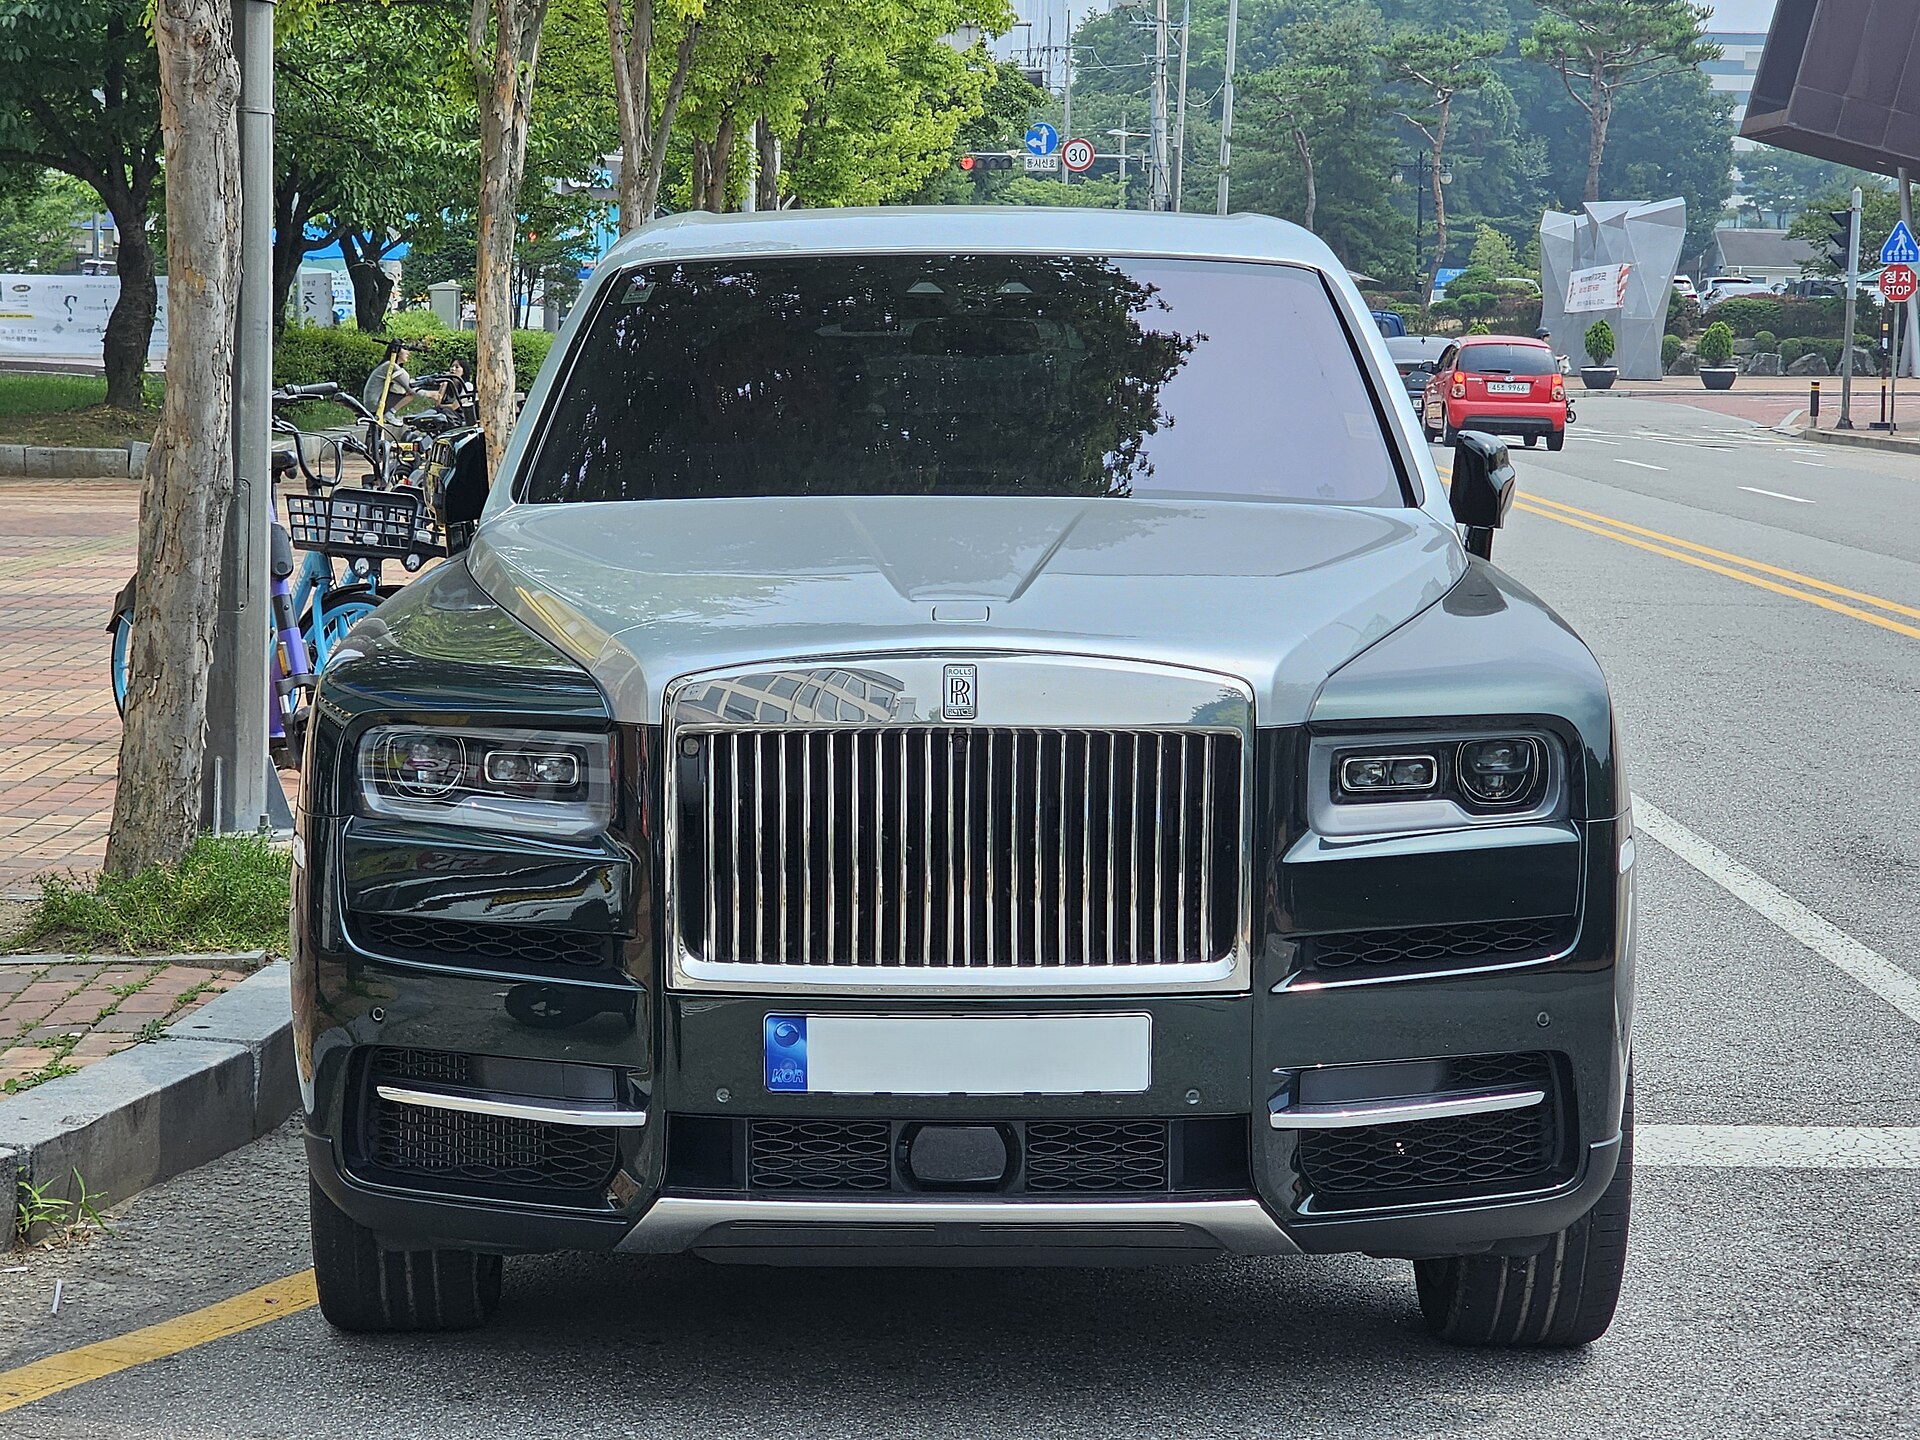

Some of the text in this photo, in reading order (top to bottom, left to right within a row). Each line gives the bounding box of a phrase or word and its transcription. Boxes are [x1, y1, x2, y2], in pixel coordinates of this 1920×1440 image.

[1069, 149, 1087, 162] 30
[1026, 159, 1056, 169] 동시신호
[1884, 285, 1911, 296] STOP
[771, 1068, 804, 1083] KOR
